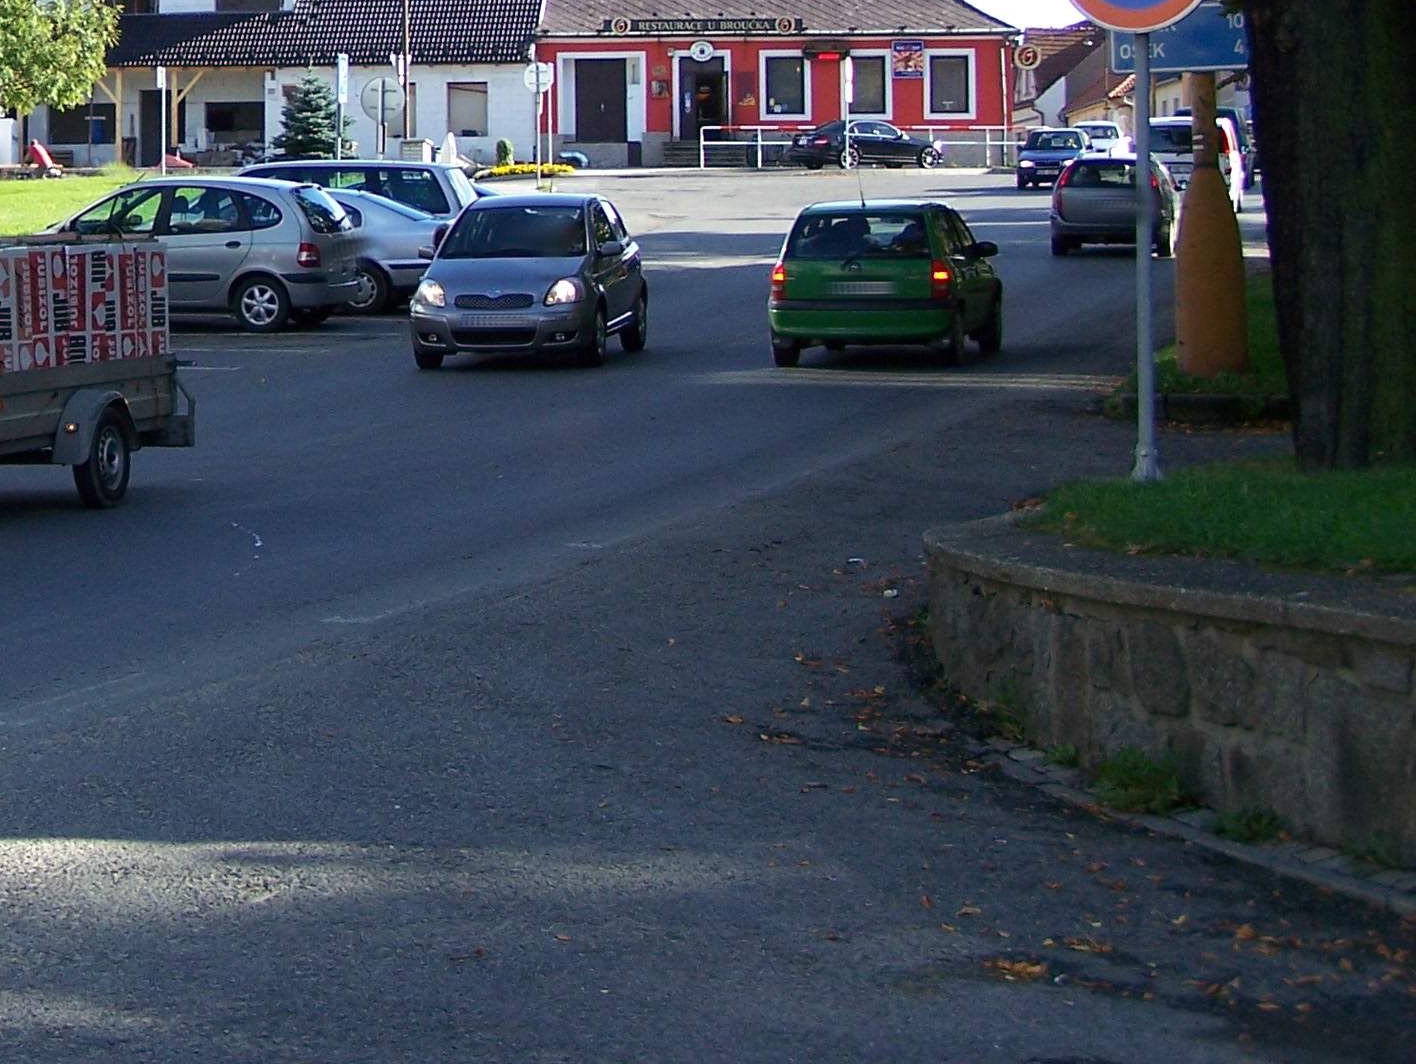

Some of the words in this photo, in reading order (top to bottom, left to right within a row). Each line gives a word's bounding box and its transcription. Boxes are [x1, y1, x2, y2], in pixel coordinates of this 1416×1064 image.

[638, 21, 703, 31] RESTAURACE
[708, 21, 716, 30] U
[720, 19, 770, 30] BROUČKA
[1225, 13, 1244, 29] 10
[1120, 42, 1165, 60] OK
[1233, 38, 1244, 54] 4
[37, 255, 48, 331] JUBIZOL
[69, 255, 79, 328] JUBIZOL
[150, 290, 166, 328] JUB
[53, 293, 69, 332] JUB
